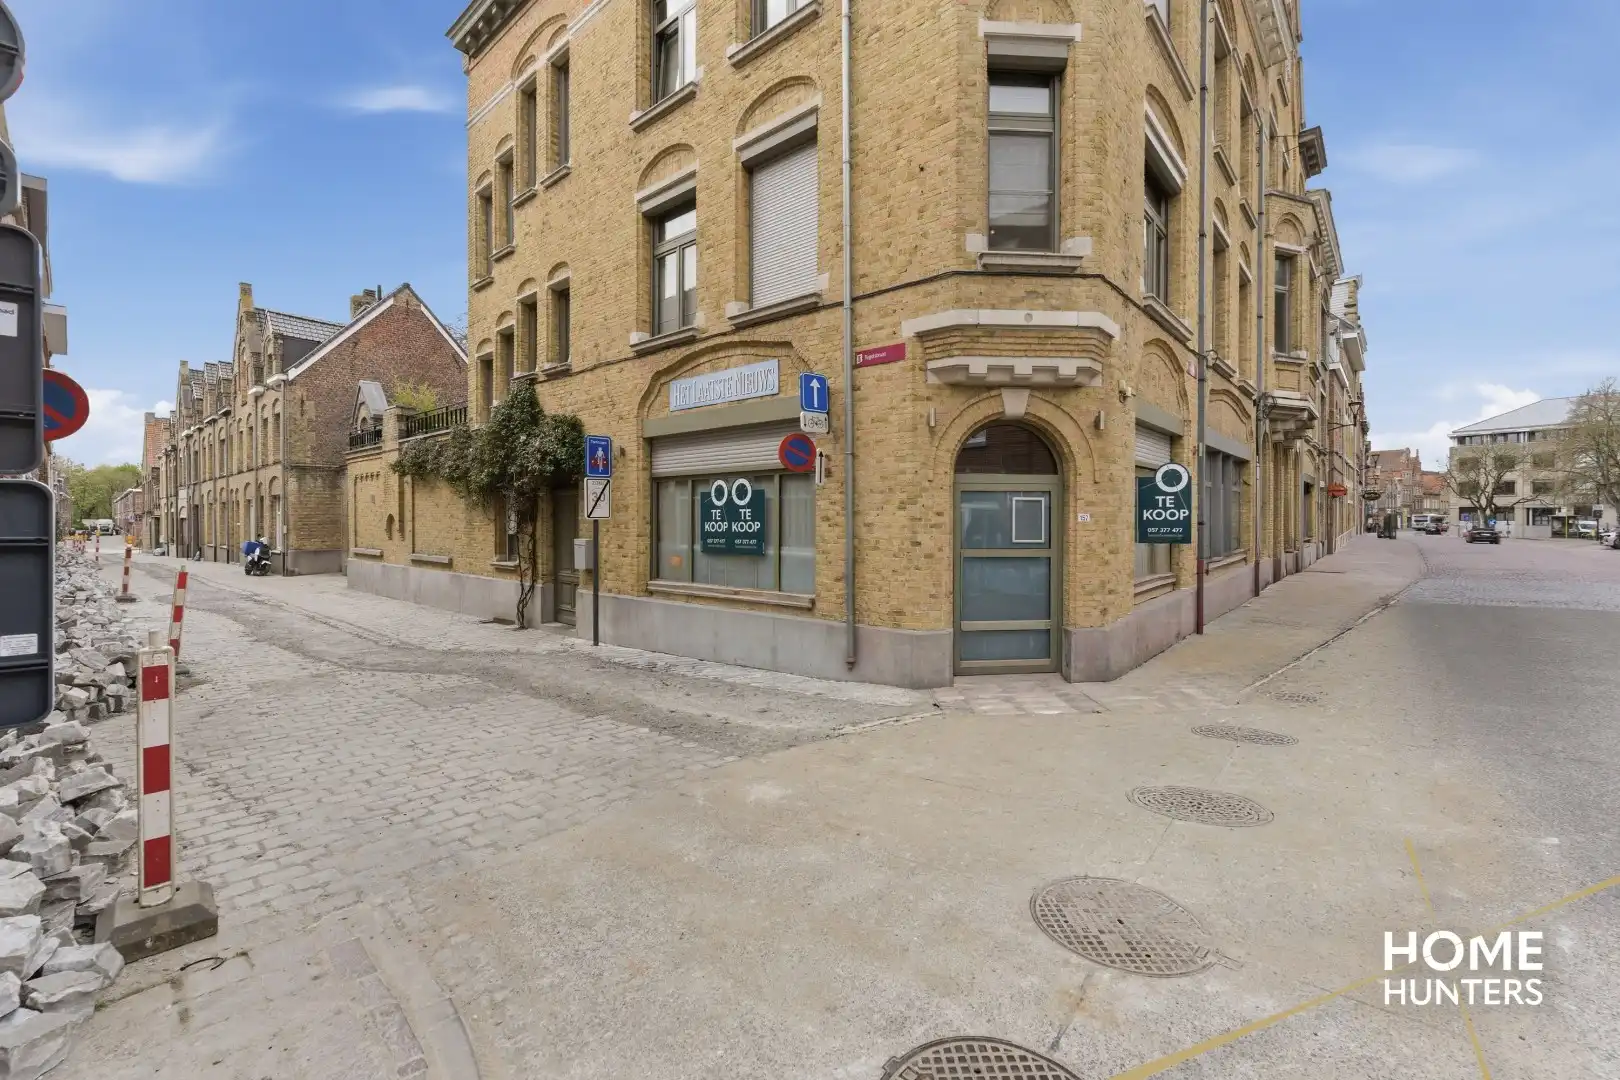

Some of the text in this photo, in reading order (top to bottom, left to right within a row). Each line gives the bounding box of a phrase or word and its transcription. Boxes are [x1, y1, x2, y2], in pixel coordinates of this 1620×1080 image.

[674, 367, 775, 408] HET LAATSTE NIEUWS
[1155, 495, 1175, 508] TE
[711, 509, 721, 520] TE
[739, 508, 752, 520] TE
[1143, 509, 1189, 521] KOOP
[704, 521, 728, 532] KOOP
[731, 521, 761, 533] KOOP
